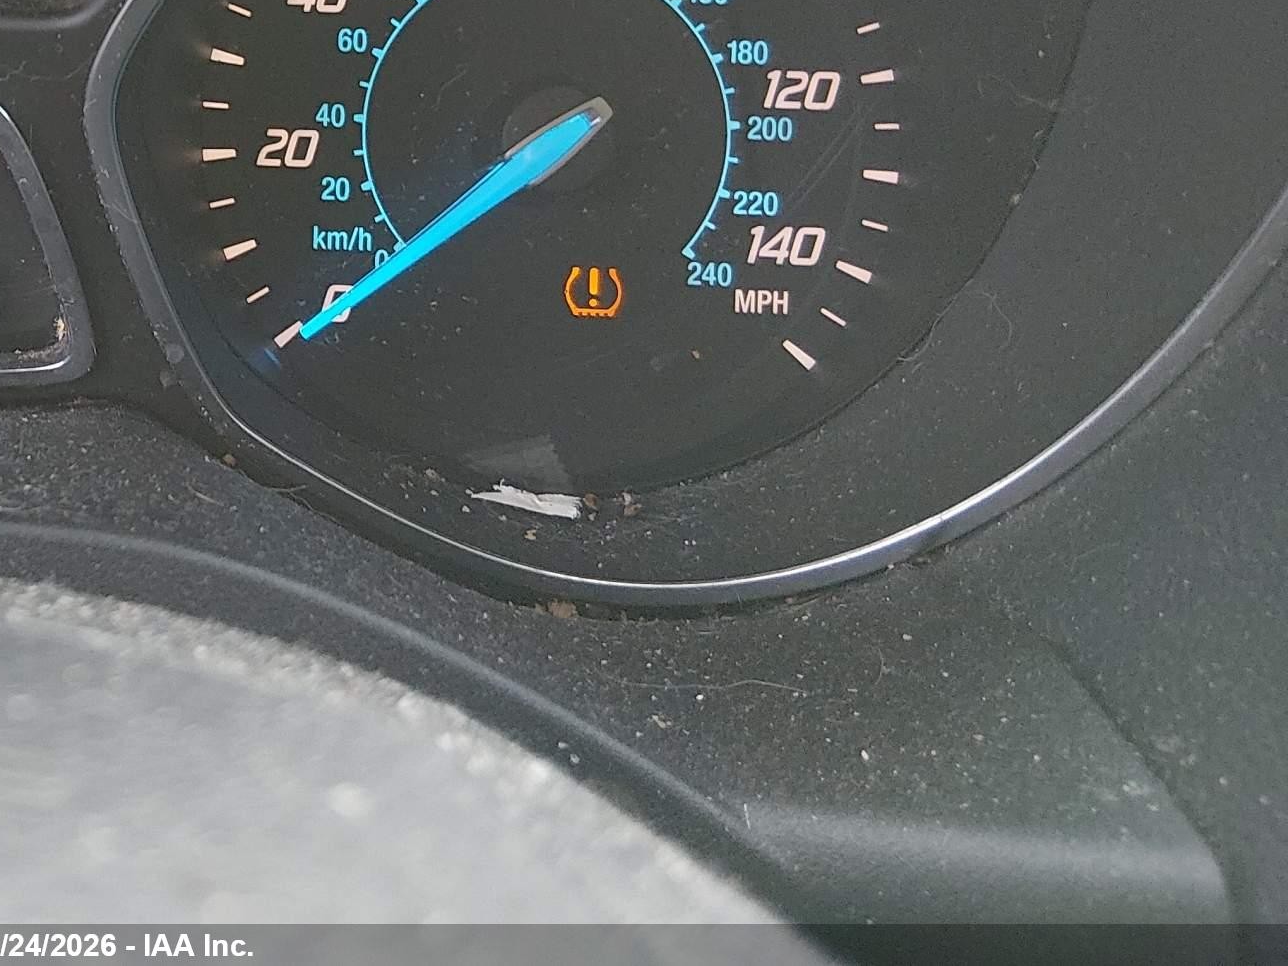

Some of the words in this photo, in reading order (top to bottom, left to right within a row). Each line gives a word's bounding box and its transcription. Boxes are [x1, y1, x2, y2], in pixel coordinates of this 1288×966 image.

[337, 29, 367, 52] 60
[727, 41, 768, 64] 180
[764, 71, 840, 110] 120
[316, 104, 346, 127] 40
[747, 117, 792, 141] 200
[256, 130, 319, 167] 20
[321, 178, 350, 201] 20
[733, 192, 778, 216] 220
[313, 226, 372, 251] km/h
[747, 226, 824, 266] 140
[687, 263, 731, 286] 240
[734, 290, 789, 315] MPH
